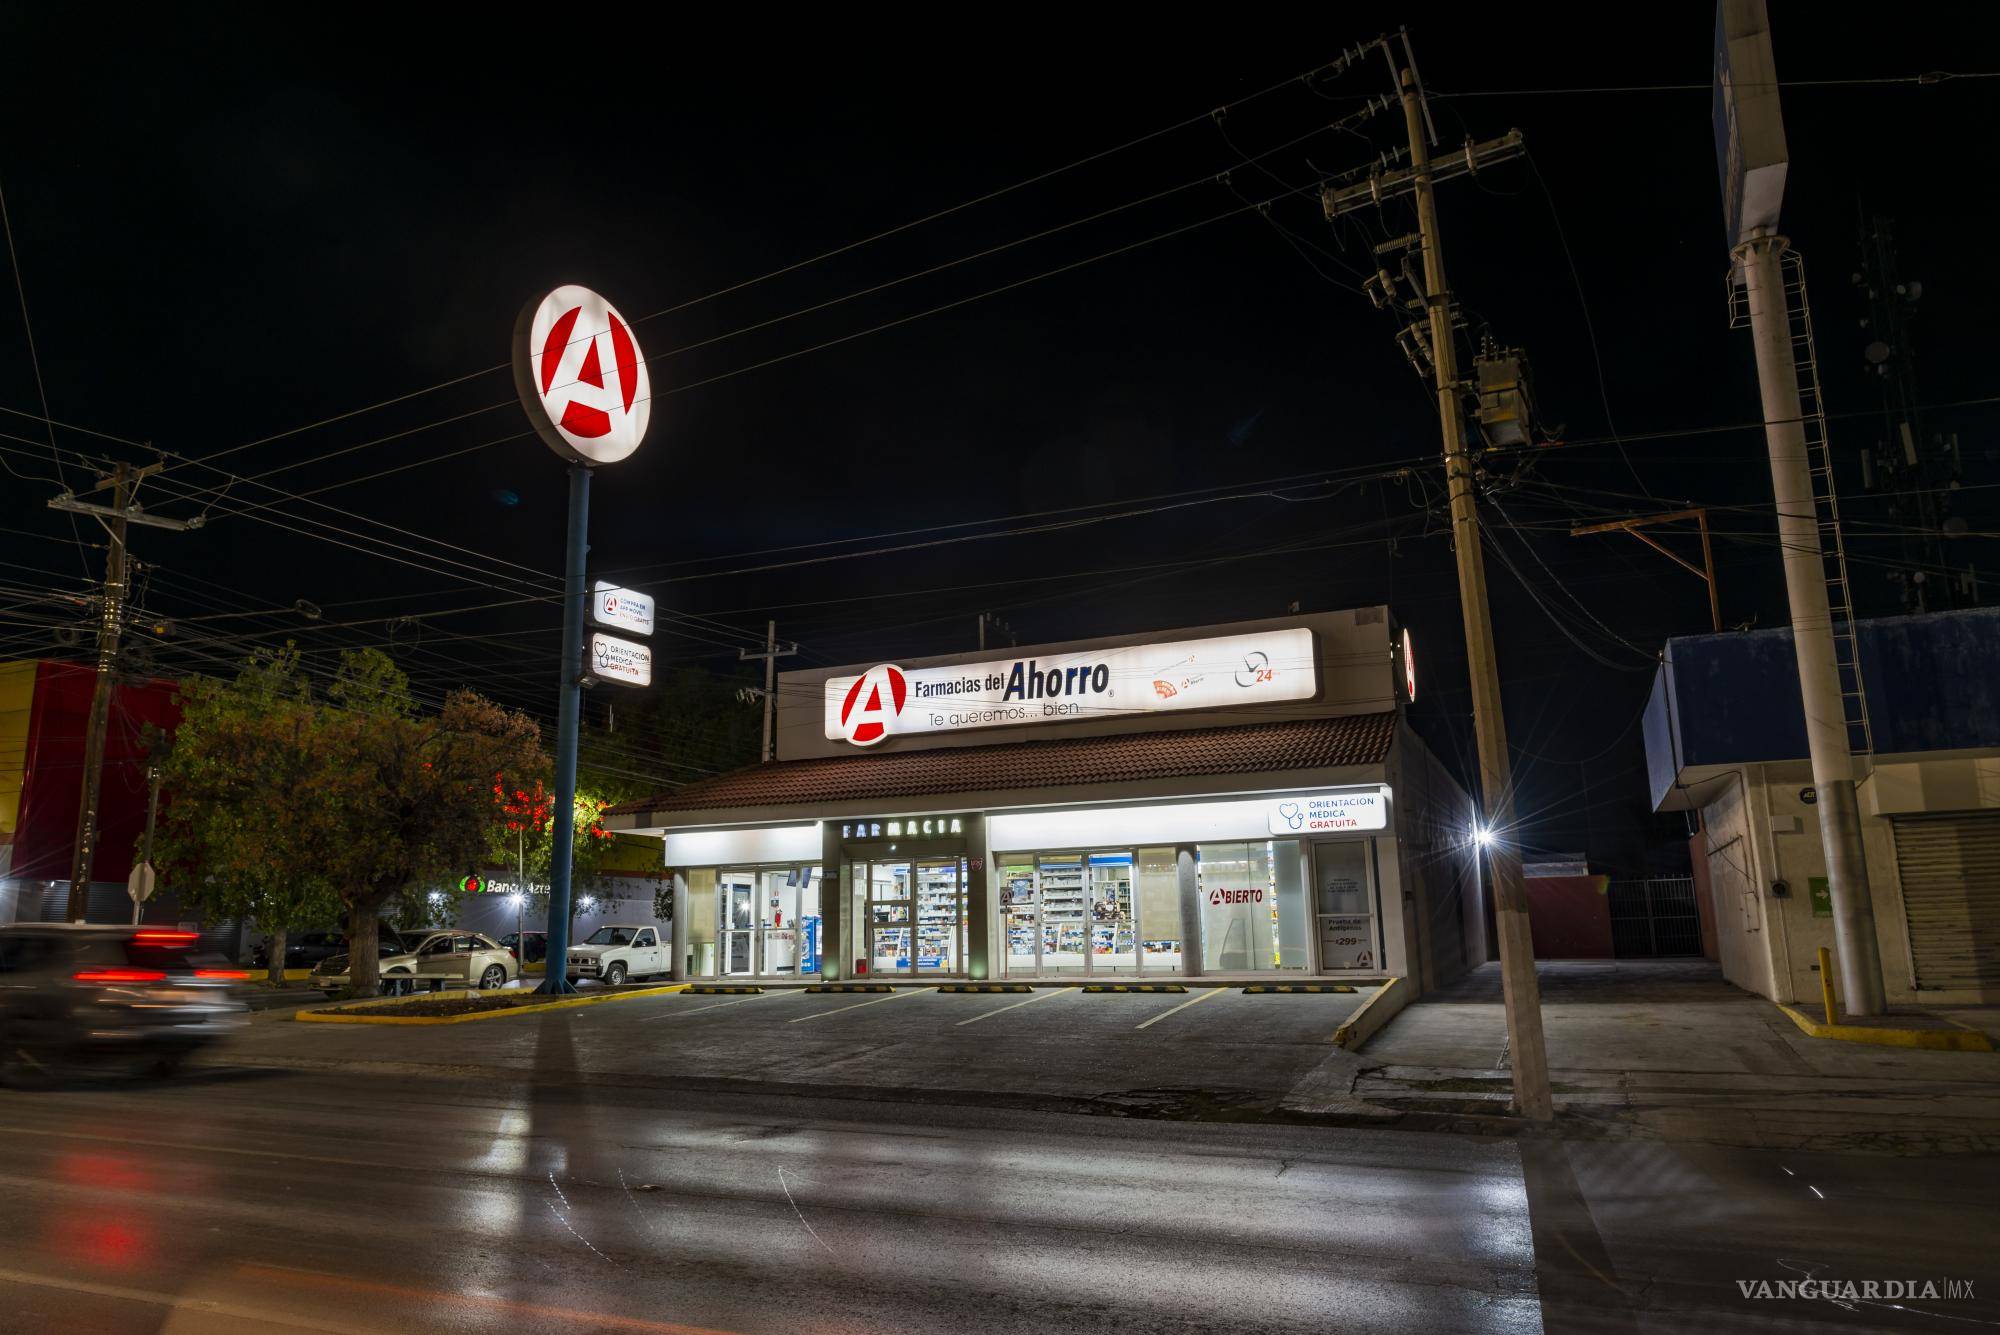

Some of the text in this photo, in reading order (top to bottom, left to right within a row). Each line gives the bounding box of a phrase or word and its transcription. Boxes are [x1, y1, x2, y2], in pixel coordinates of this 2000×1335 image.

[610, 663, 639, 676] GRATUITA
[1256, 669, 1273, 682] 24
[915, 660, 1110, 701] Farmacias del Ahorro
[929, 713, 944, 727] Te
[1043, 702, 1079, 717] bien
[842, 819, 961, 839] FARMACIA
[1309, 819, 1357, 829] GRATUITA
